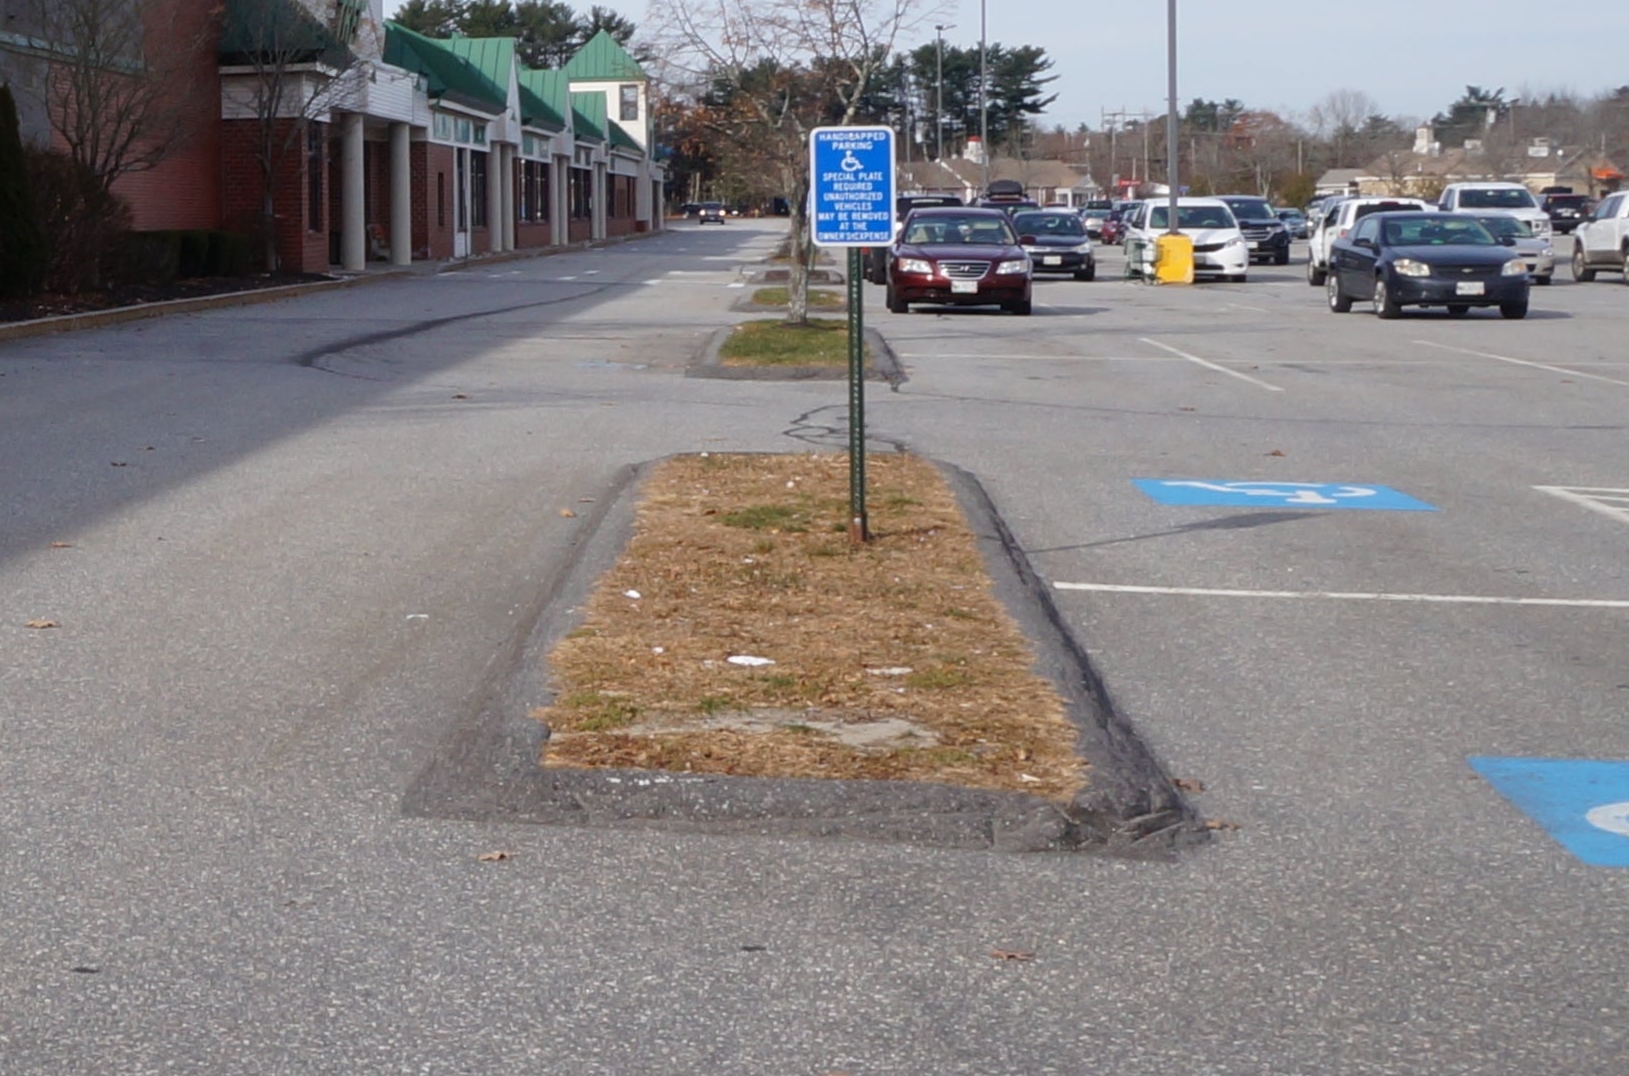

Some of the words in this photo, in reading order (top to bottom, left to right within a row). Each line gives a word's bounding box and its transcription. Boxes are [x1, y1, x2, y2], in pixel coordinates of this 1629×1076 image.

[818, 132, 886, 141] HANDICAPPED
[832, 141, 873, 150] PARKING
[823, 172, 855, 181] SPECIAL
[858, 171, 883, 181] PLATE
[833, 182, 873, 191] REQUIRED
[823, 192, 883, 201] UNAUTHORIZED
[834, 201, 872, 211] VEHICLES
[818, 212, 835, 220] MAY
[838, 212, 848, 221] BE
[851, 212, 889, 221] REMOVED
[839, 222, 849, 230] AT
[853, 222, 867, 231] THE
[854, 232, 889, 240] EXPENSE
